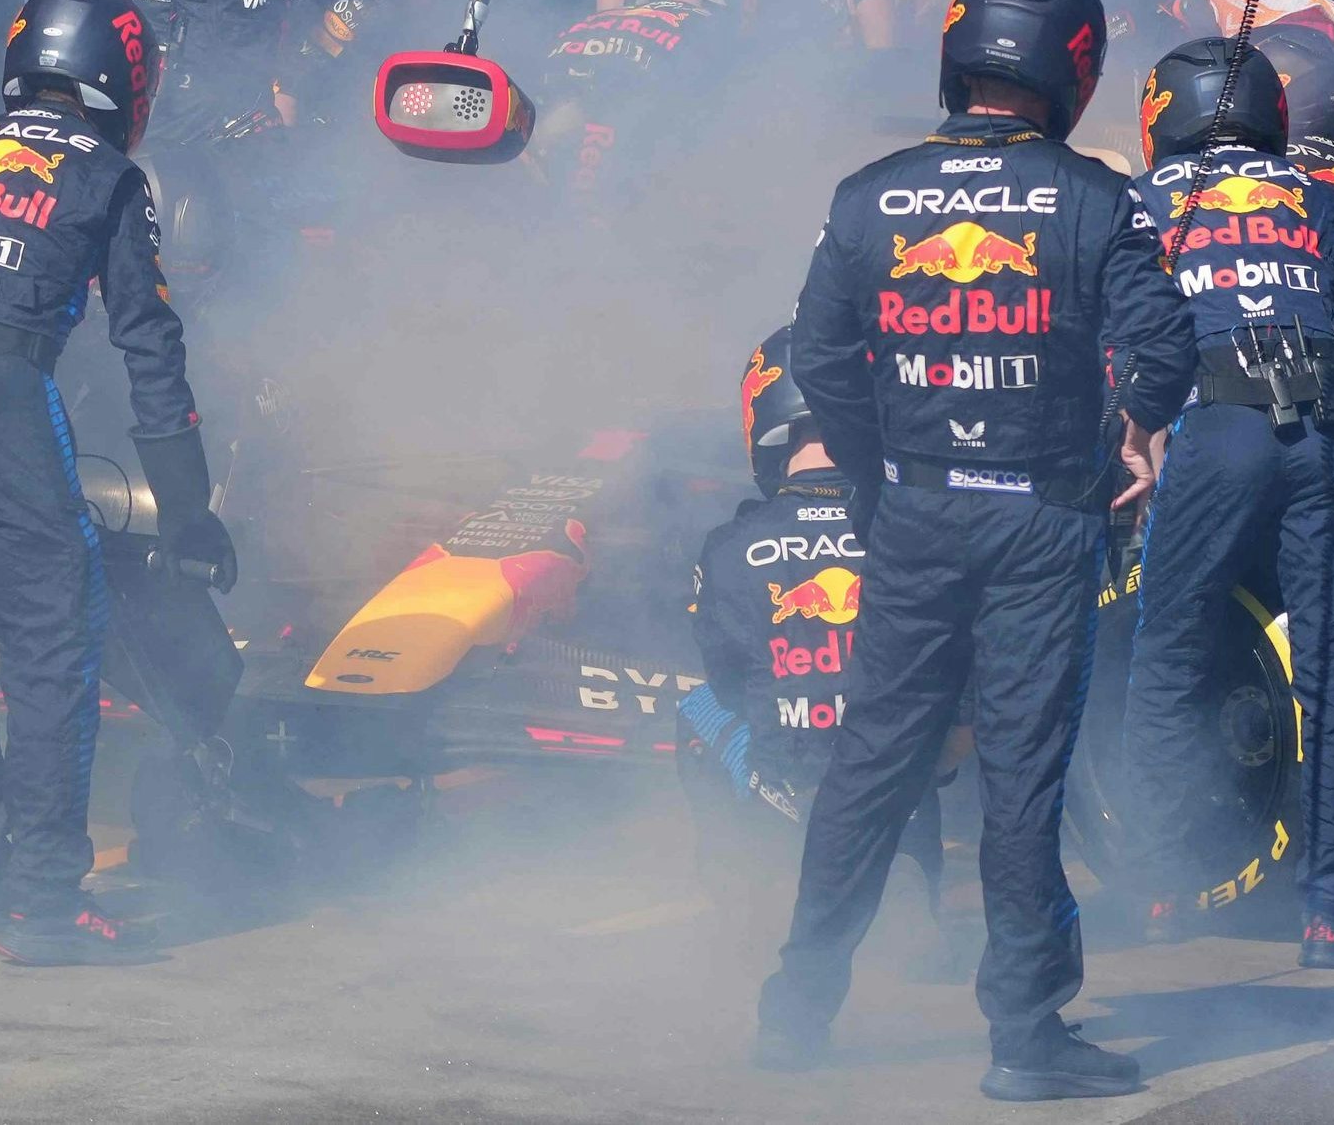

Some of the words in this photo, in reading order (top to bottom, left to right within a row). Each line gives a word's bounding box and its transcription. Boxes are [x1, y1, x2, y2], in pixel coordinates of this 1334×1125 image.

[940, 156, 1002, 173] sparco
[879, 186, 1059, 215] ORACLE
[1179, 258, 1281, 298] Mobil
[895, 353, 995, 389] Mobil
[530, 474, 604, 489] VISA
[948, 467, 1032, 491] sparco
[490, 500, 577, 513] zoom
[797, 507, 846, 521] sparc
[447, 536, 512, 548] Mobil
[746, 532, 866, 567] ORAC
[346, 648, 401, 662] HRC
